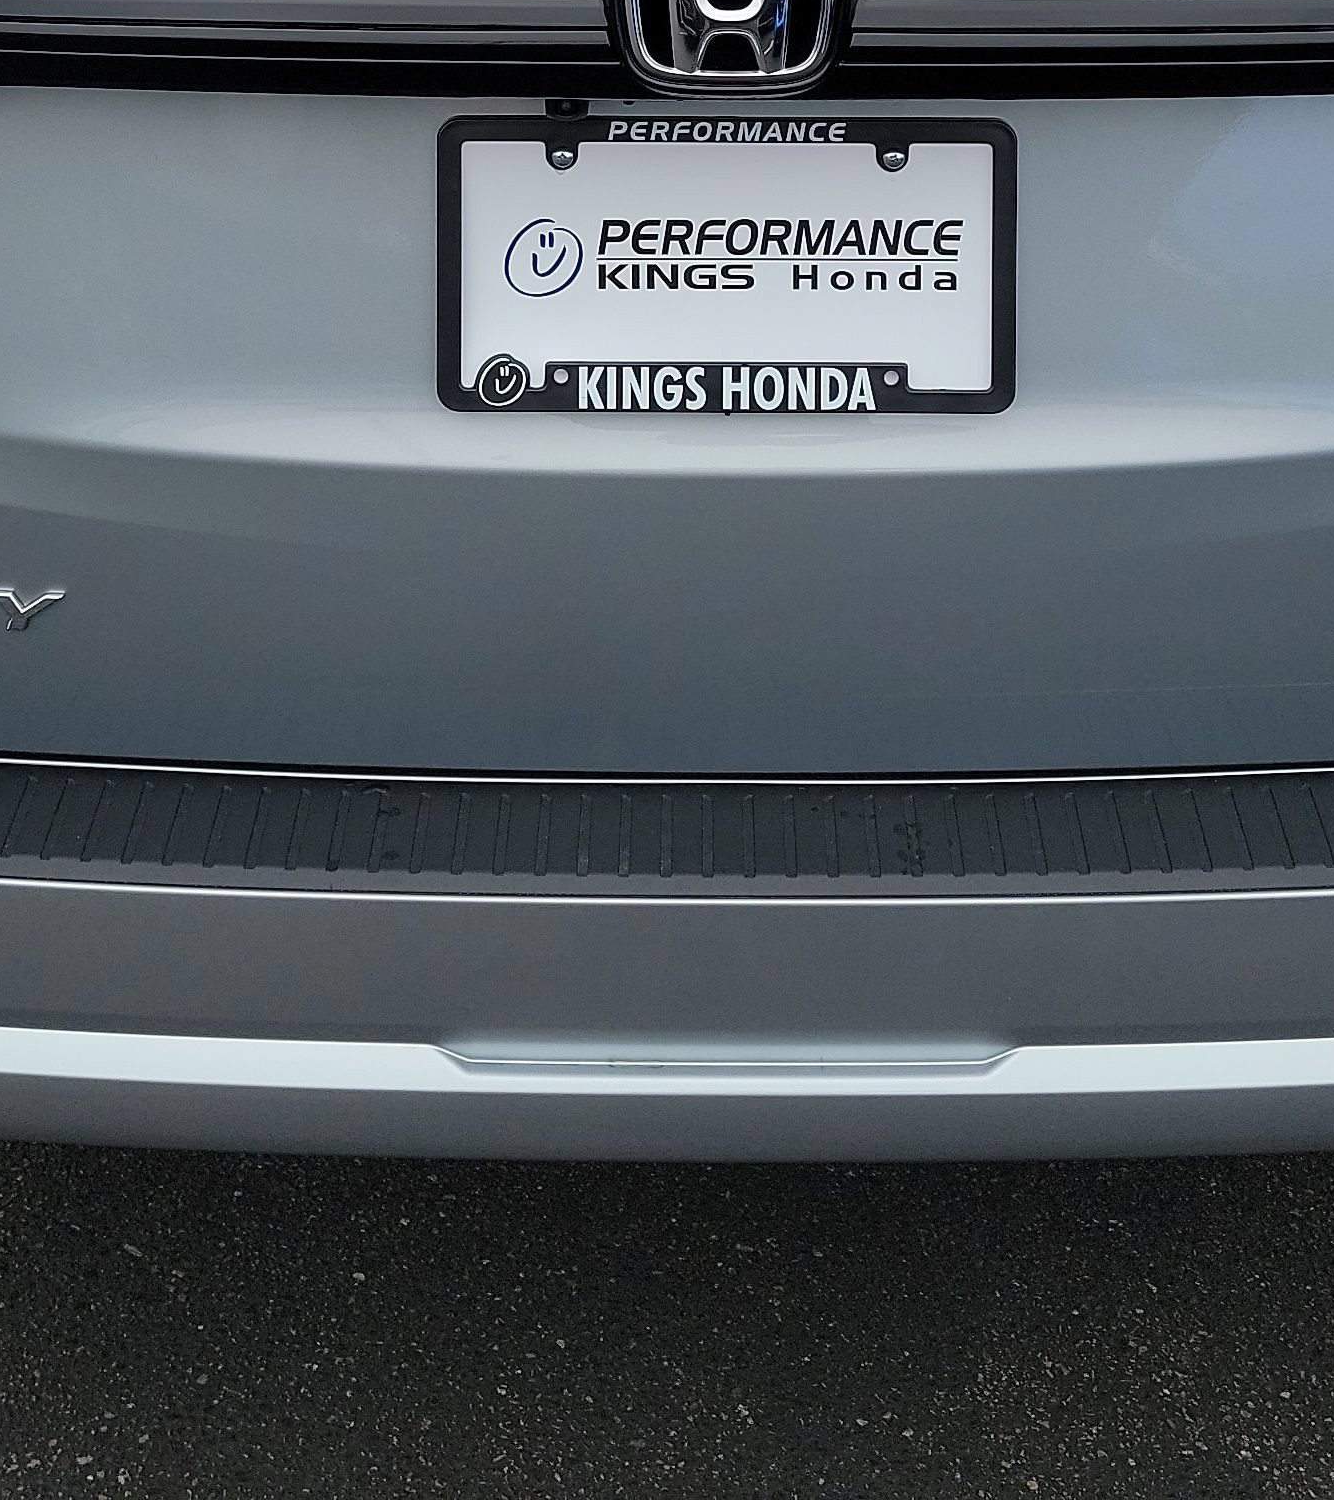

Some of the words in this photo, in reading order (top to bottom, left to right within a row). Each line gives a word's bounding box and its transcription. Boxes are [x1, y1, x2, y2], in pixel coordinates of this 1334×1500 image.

[607, 121, 848, 142] PERFORMANCE
[597, 219, 965, 256] PERFORMANCE
[597, 263, 755, 291] KINGS
[792, 264, 958, 291] Honda
[578, 366, 707, 411] KINGS
[722, 366, 877, 411] HONDA
